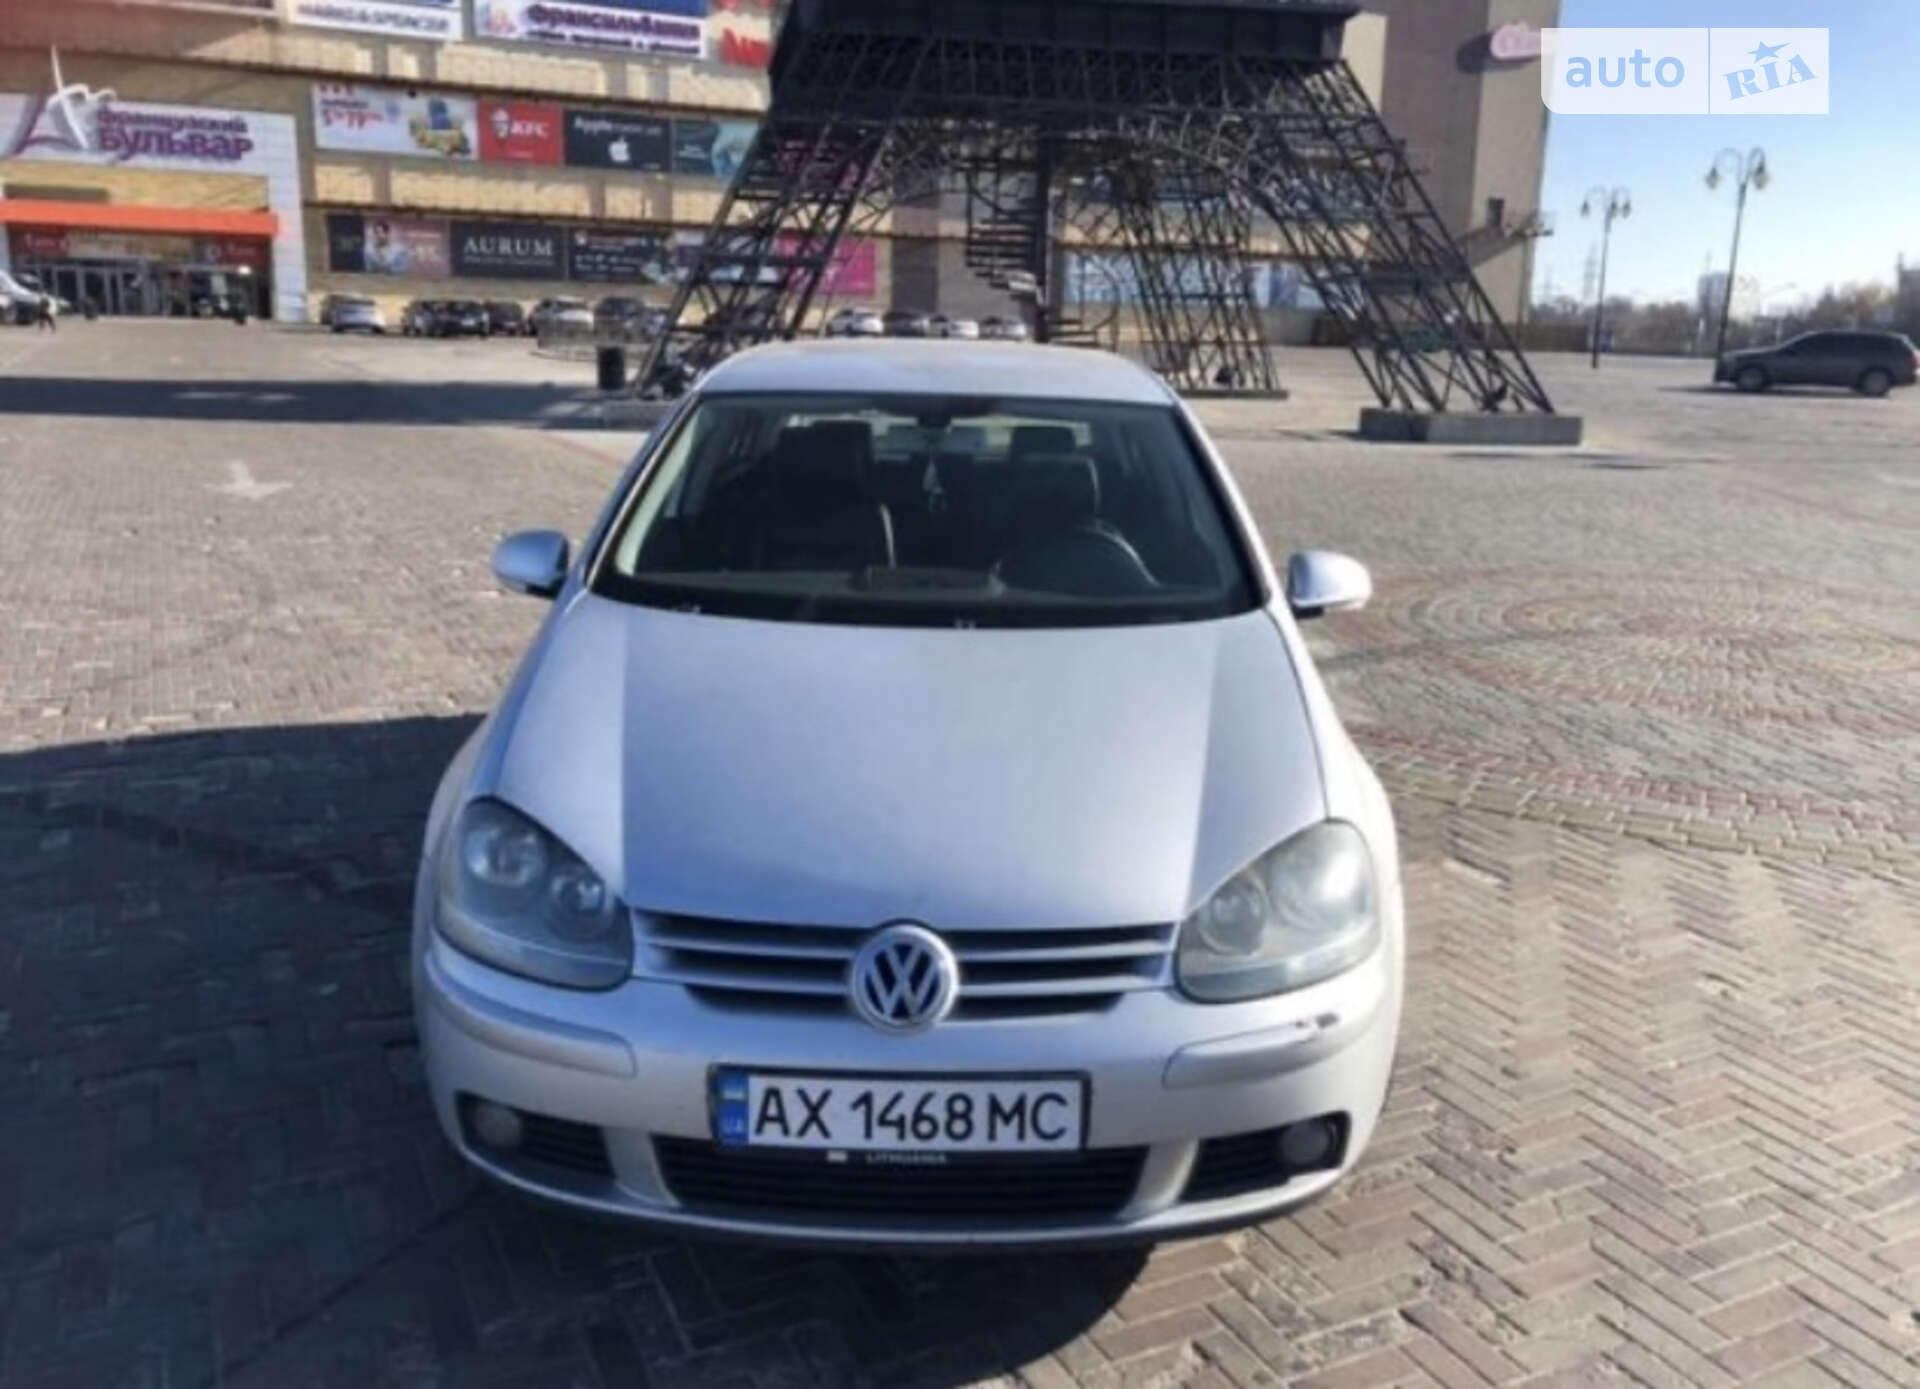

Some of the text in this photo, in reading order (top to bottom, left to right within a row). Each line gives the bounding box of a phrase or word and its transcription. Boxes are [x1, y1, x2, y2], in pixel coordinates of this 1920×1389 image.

[510, 120, 547, 138] KFC
[464, 235, 553, 257] AURUM
[755, 1087, 1069, 1142] AX 1468 MC
